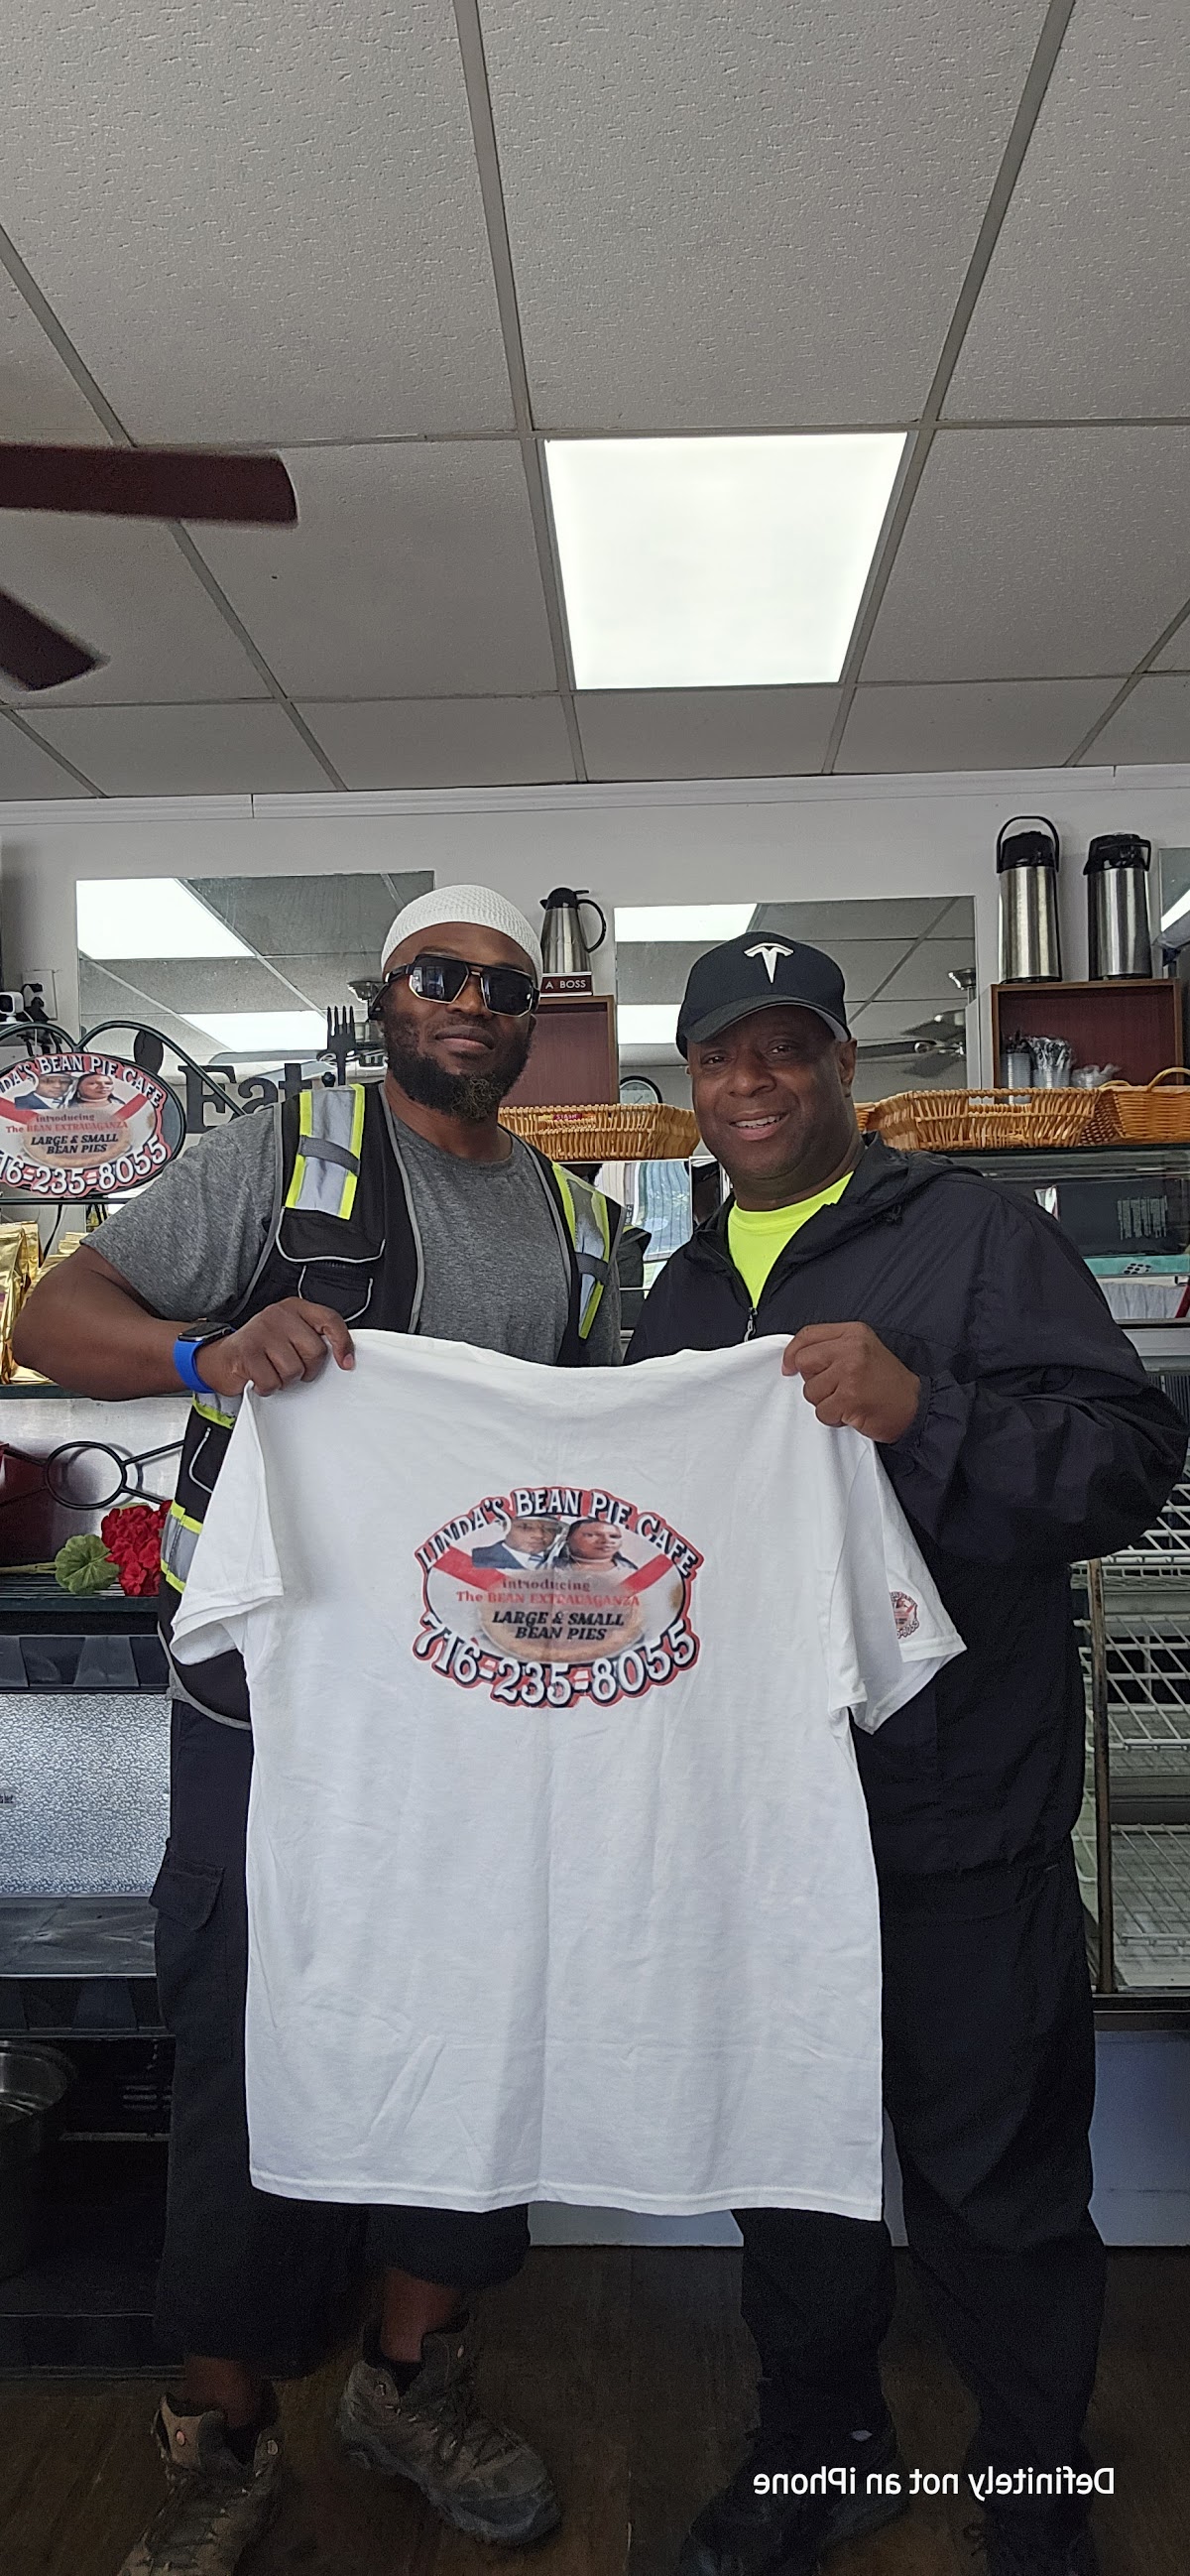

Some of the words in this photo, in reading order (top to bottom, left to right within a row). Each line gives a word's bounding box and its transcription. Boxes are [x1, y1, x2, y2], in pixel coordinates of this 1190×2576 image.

[545, 981, 554, 990] A
[559, 979, 586, 989] BOSS
[37, 1055, 84, 1075] BEAN
[89, 1056, 118, 1079] PIE
[122, 1068, 165, 1108] CAFE
[36, 1113, 95, 1123] introducing
[6, 1125, 24, 1134] The
[27, 1124, 53, 1133] BEAN
[31, 1135, 68, 1147] LARGE
[69, 1135, 78, 1145] &
[80, 1133, 119, 1144] SMALL
[47, 1145, 79, 1155] BEAN
[80, 1144, 108, 1154] PIES
[417, 1499, 513, 1568] LINDA'S
[514, 1488, 582, 1518] BEAN
[588, 1491, 632, 1530] PIE
[637, 1515, 697, 1579] CAFE
[502, 1578, 591, 1593] introducing
[456, 1591, 483, 1602] The
[487, 1592, 526, 1604] BEAN
[492, 1611, 549, 1628] LARGE
[551, 1611, 565, 1625] &
[567, 1612, 625, 1627] SMALL
[514, 1626, 564, 1640] BEAN
[566, 1627, 608, 1641] PIES
[416, 1613, 695, 1706] 716-235-8055
